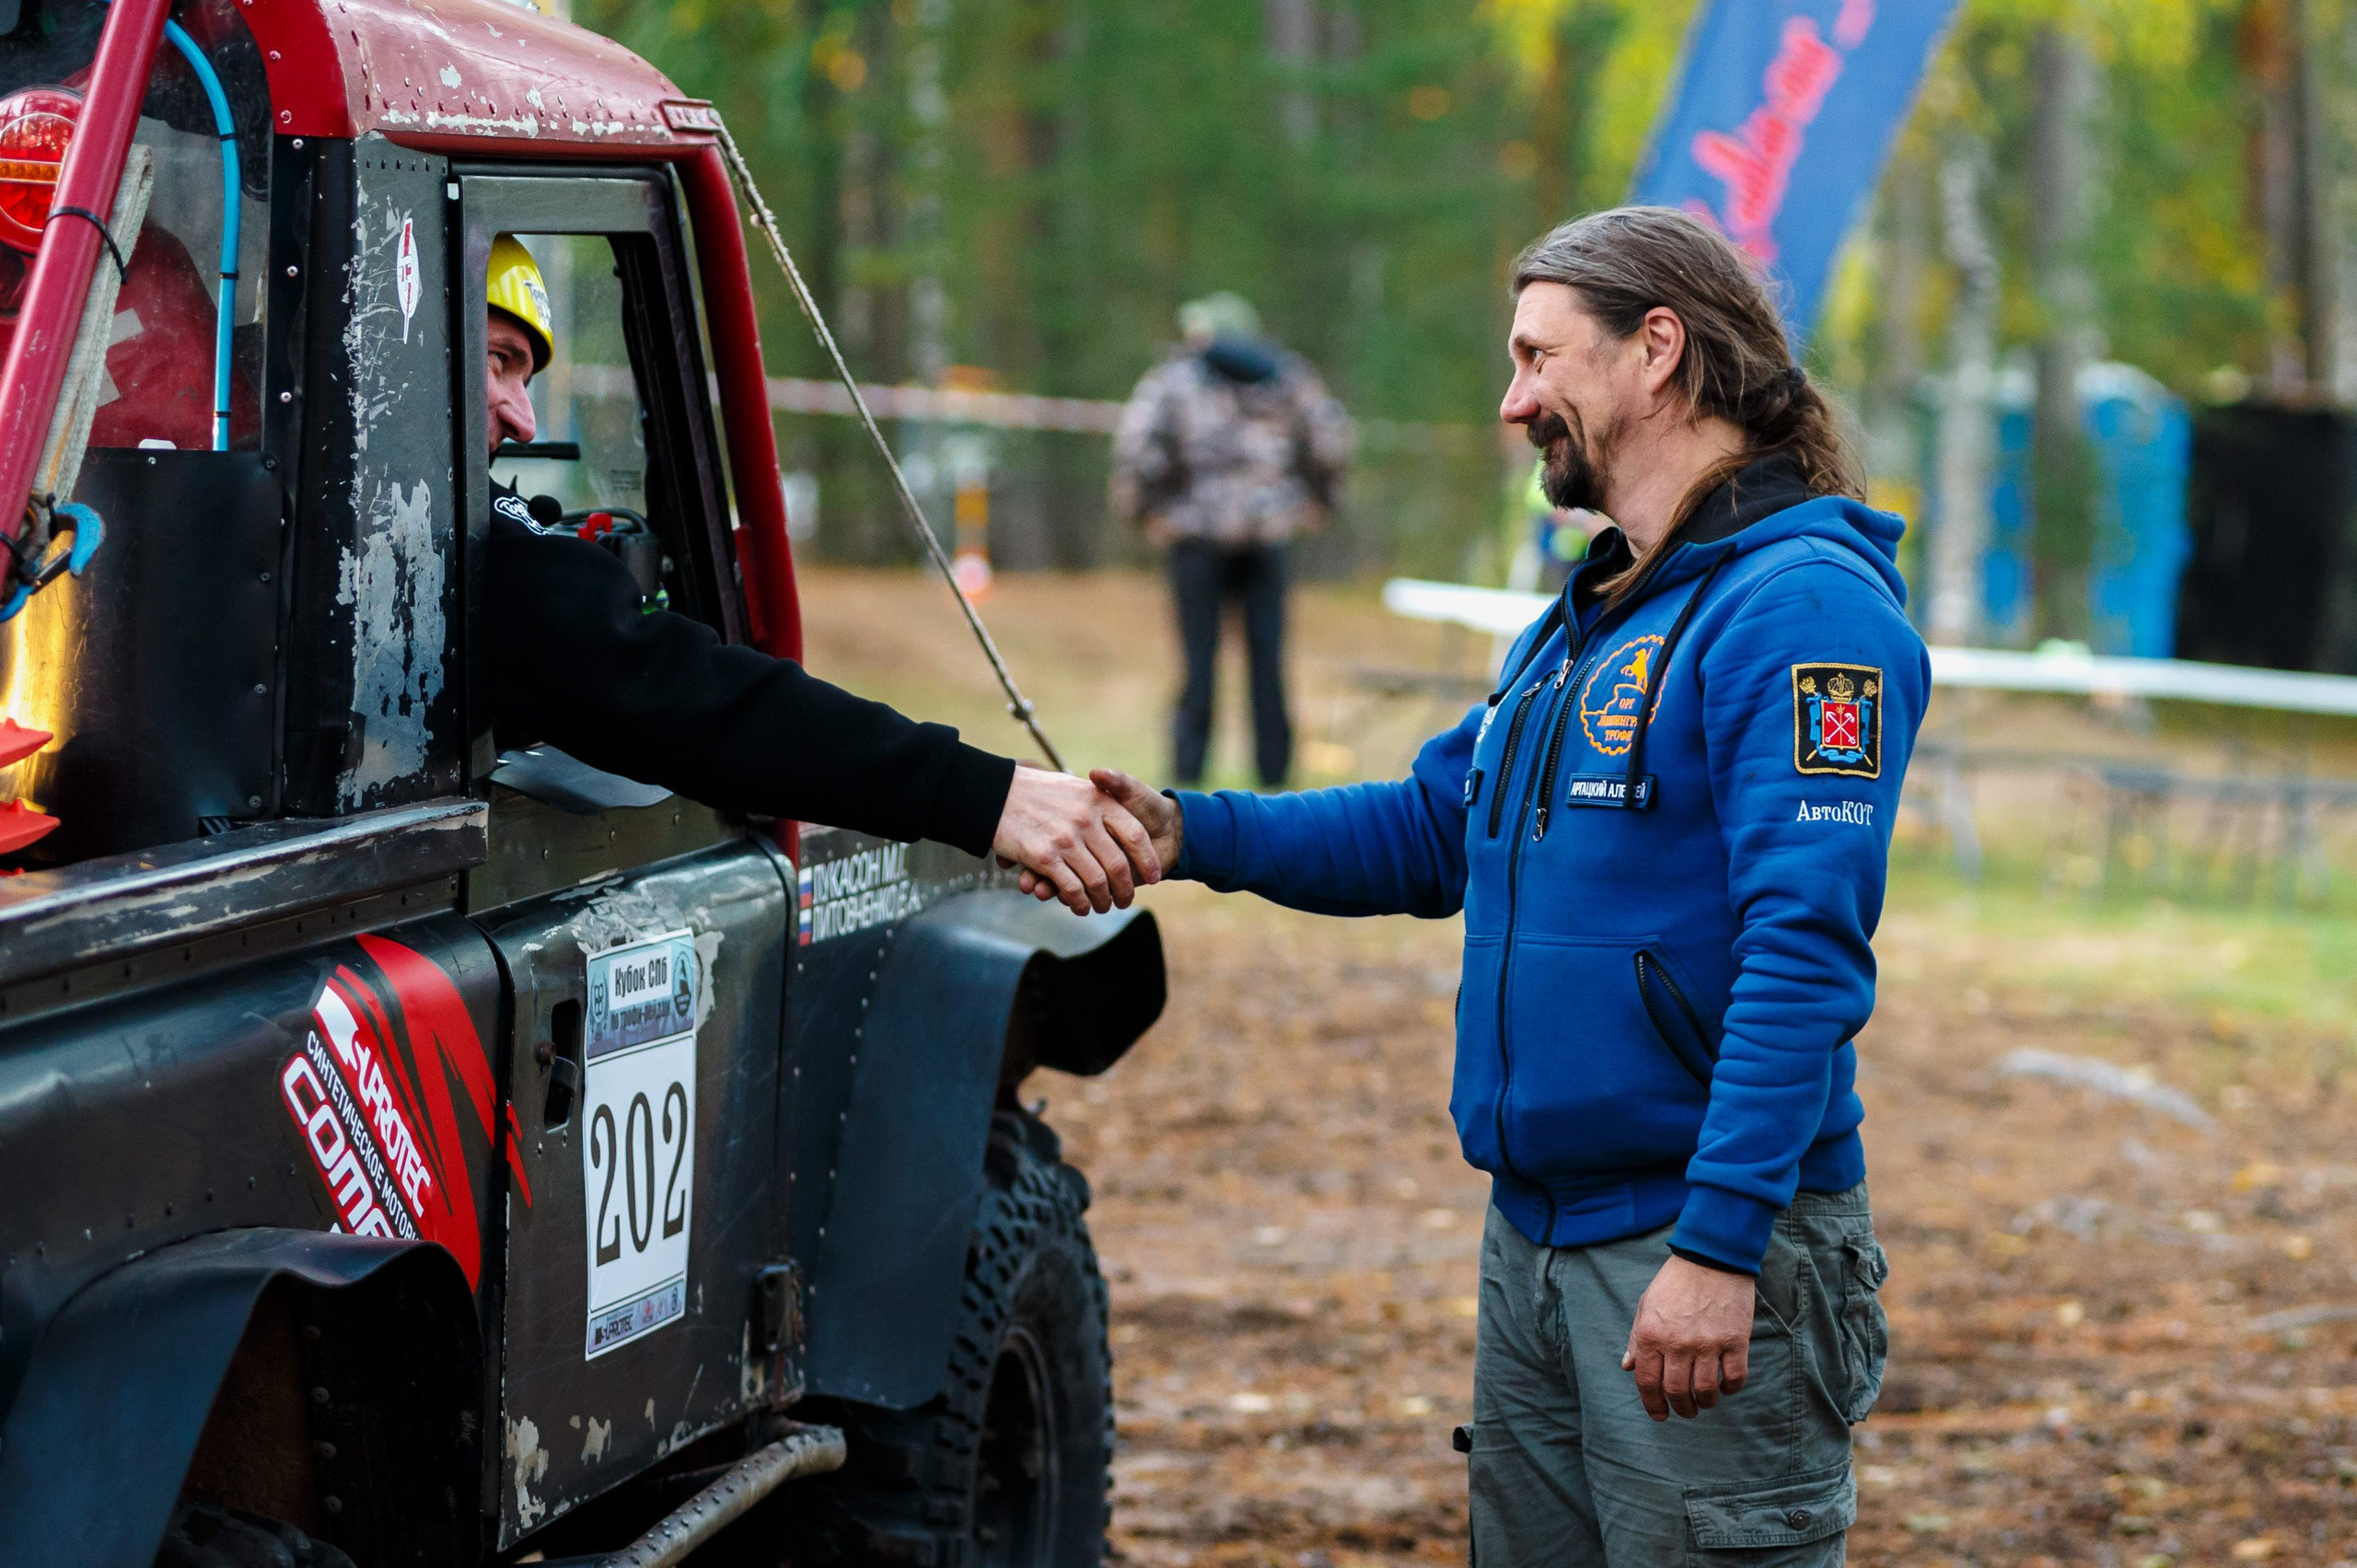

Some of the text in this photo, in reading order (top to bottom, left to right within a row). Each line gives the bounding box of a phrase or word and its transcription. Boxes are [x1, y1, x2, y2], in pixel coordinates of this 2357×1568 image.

[1608, 782, 1646, 799] АЛЕЕЙ
[615, 957, 668, 998] Кубок СПб
[307, 1030, 420, 1240] СИНТЕТИЧЕСКОЕ МОТОР
[590, 1081, 688, 1268] 202
